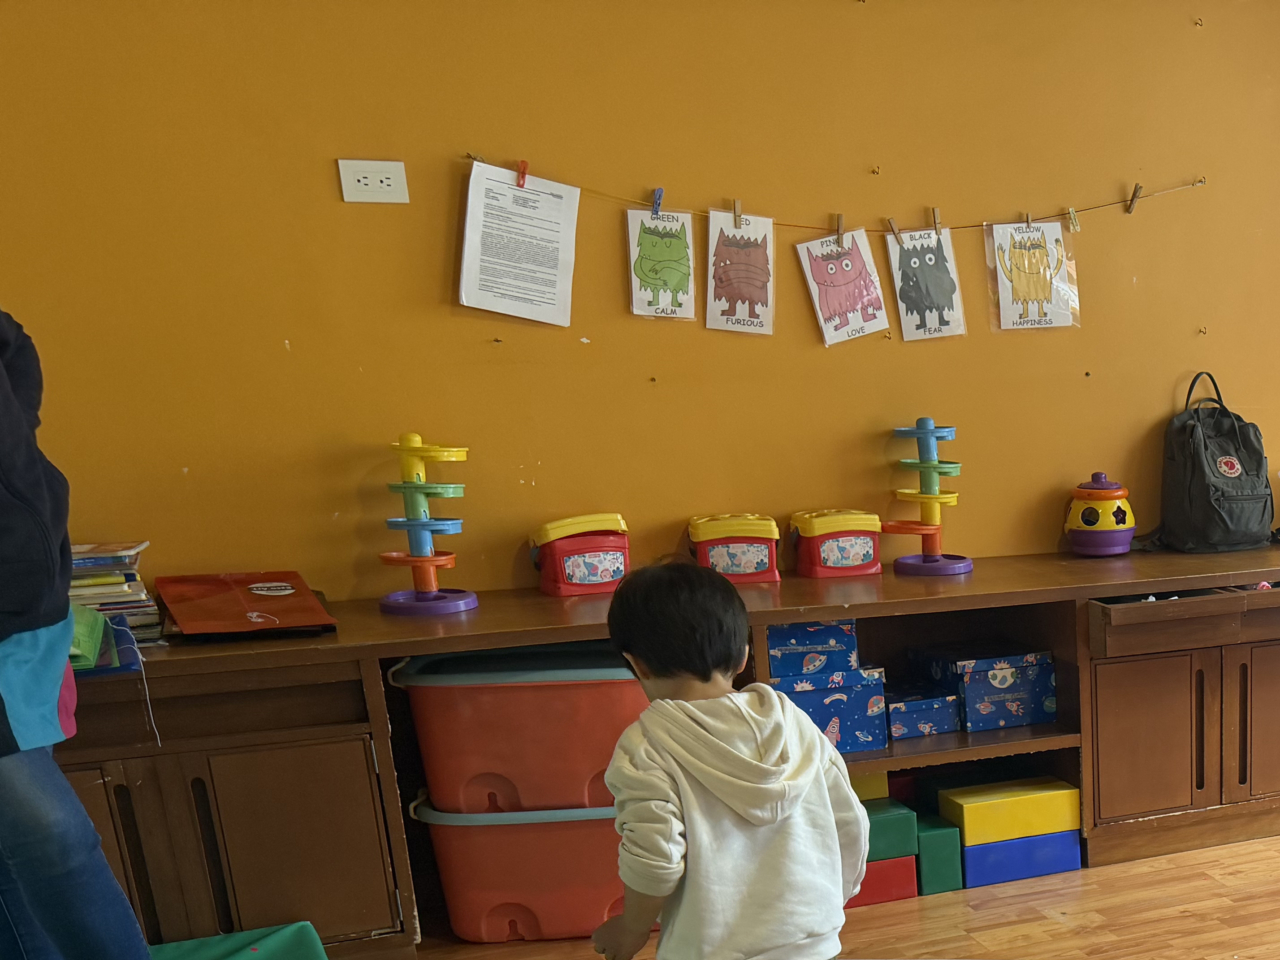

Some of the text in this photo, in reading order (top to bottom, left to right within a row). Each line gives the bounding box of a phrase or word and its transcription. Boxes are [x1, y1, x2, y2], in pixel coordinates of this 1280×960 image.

[651, 214, 679, 223] GREEN
[1013, 226, 1042, 234] YELLOW
[909, 232, 932, 242] BLACK
[654, 307, 677, 316] CALM
[725, 317, 764, 328] FURIOUS
[1012, 319, 1053, 327] HAPPINESS
[846, 326, 866, 338] LOVE
[923, 327, 943, 335] FEAR
